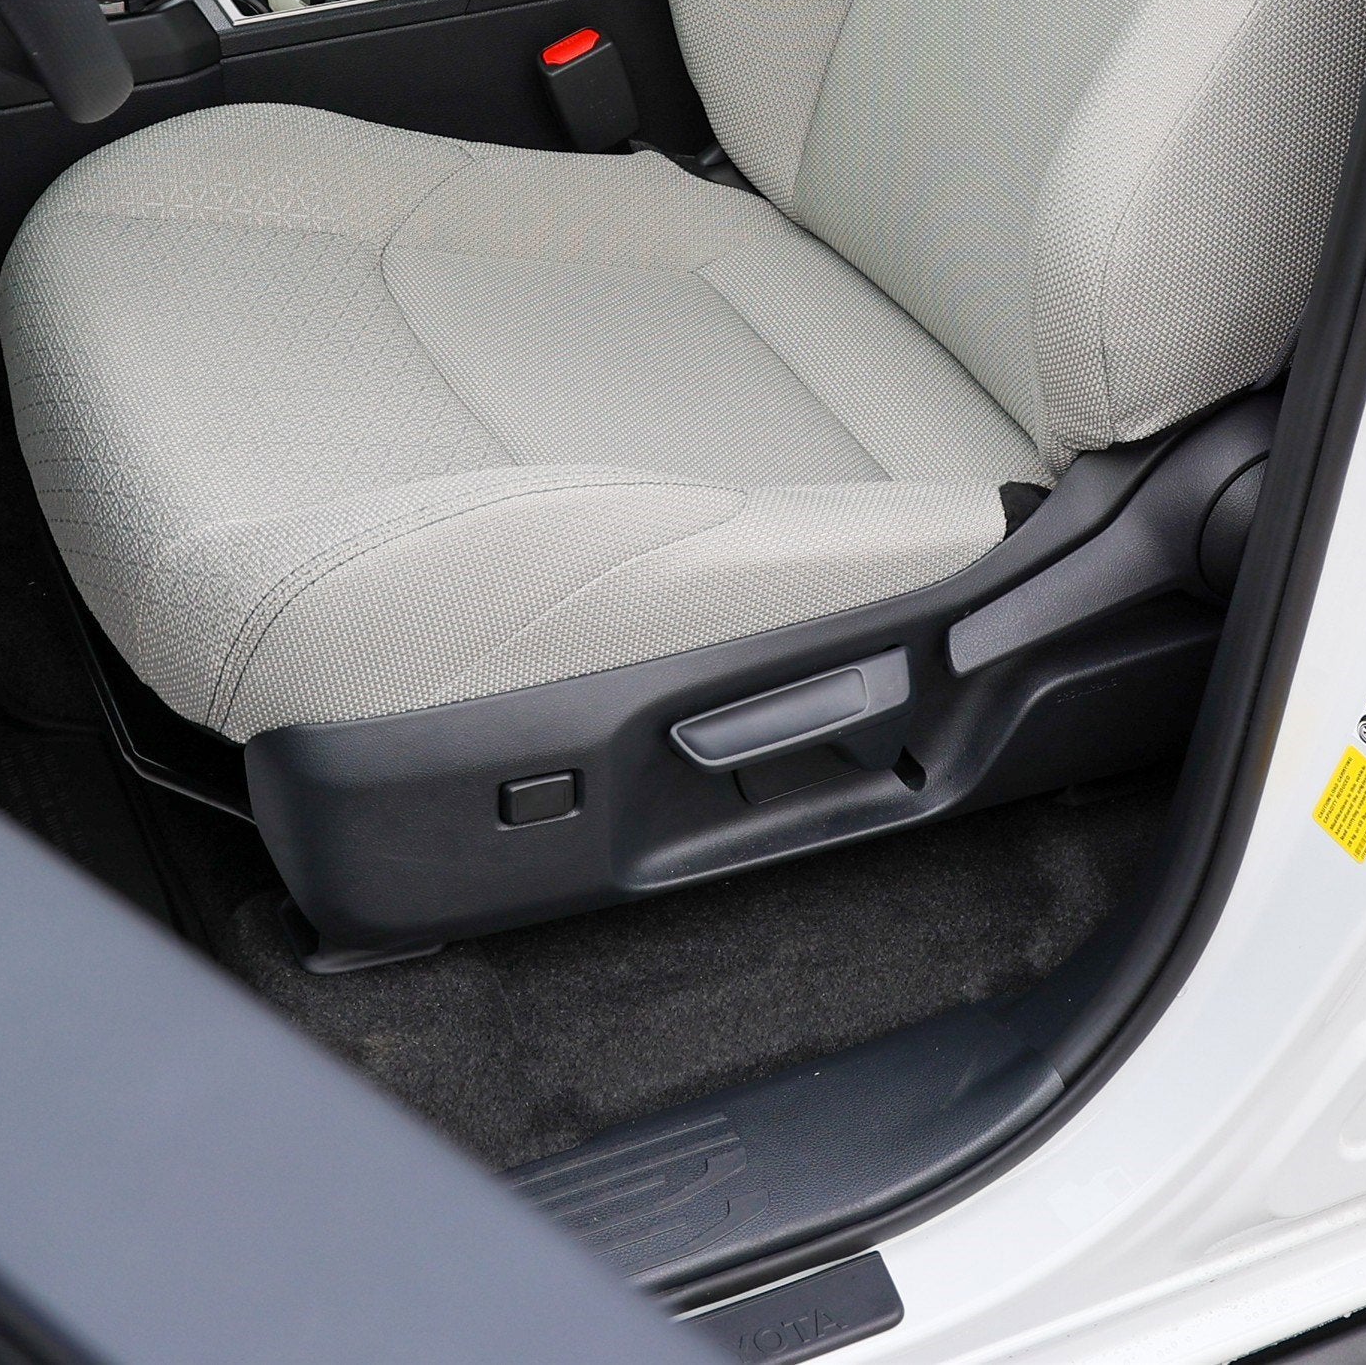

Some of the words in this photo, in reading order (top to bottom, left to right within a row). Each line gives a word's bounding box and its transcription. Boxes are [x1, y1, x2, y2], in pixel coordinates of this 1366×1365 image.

[1337, 757, 1353, 783] CARRYING
[1323, 800, 1337, 824] CAPACITY
[1336, 775, 1350, 799] REDUCED
[1335, 823, 1343, 835] have
[1342, 803, 1354, 823] reduced
[1347, 810, 1359, 829] carrying
